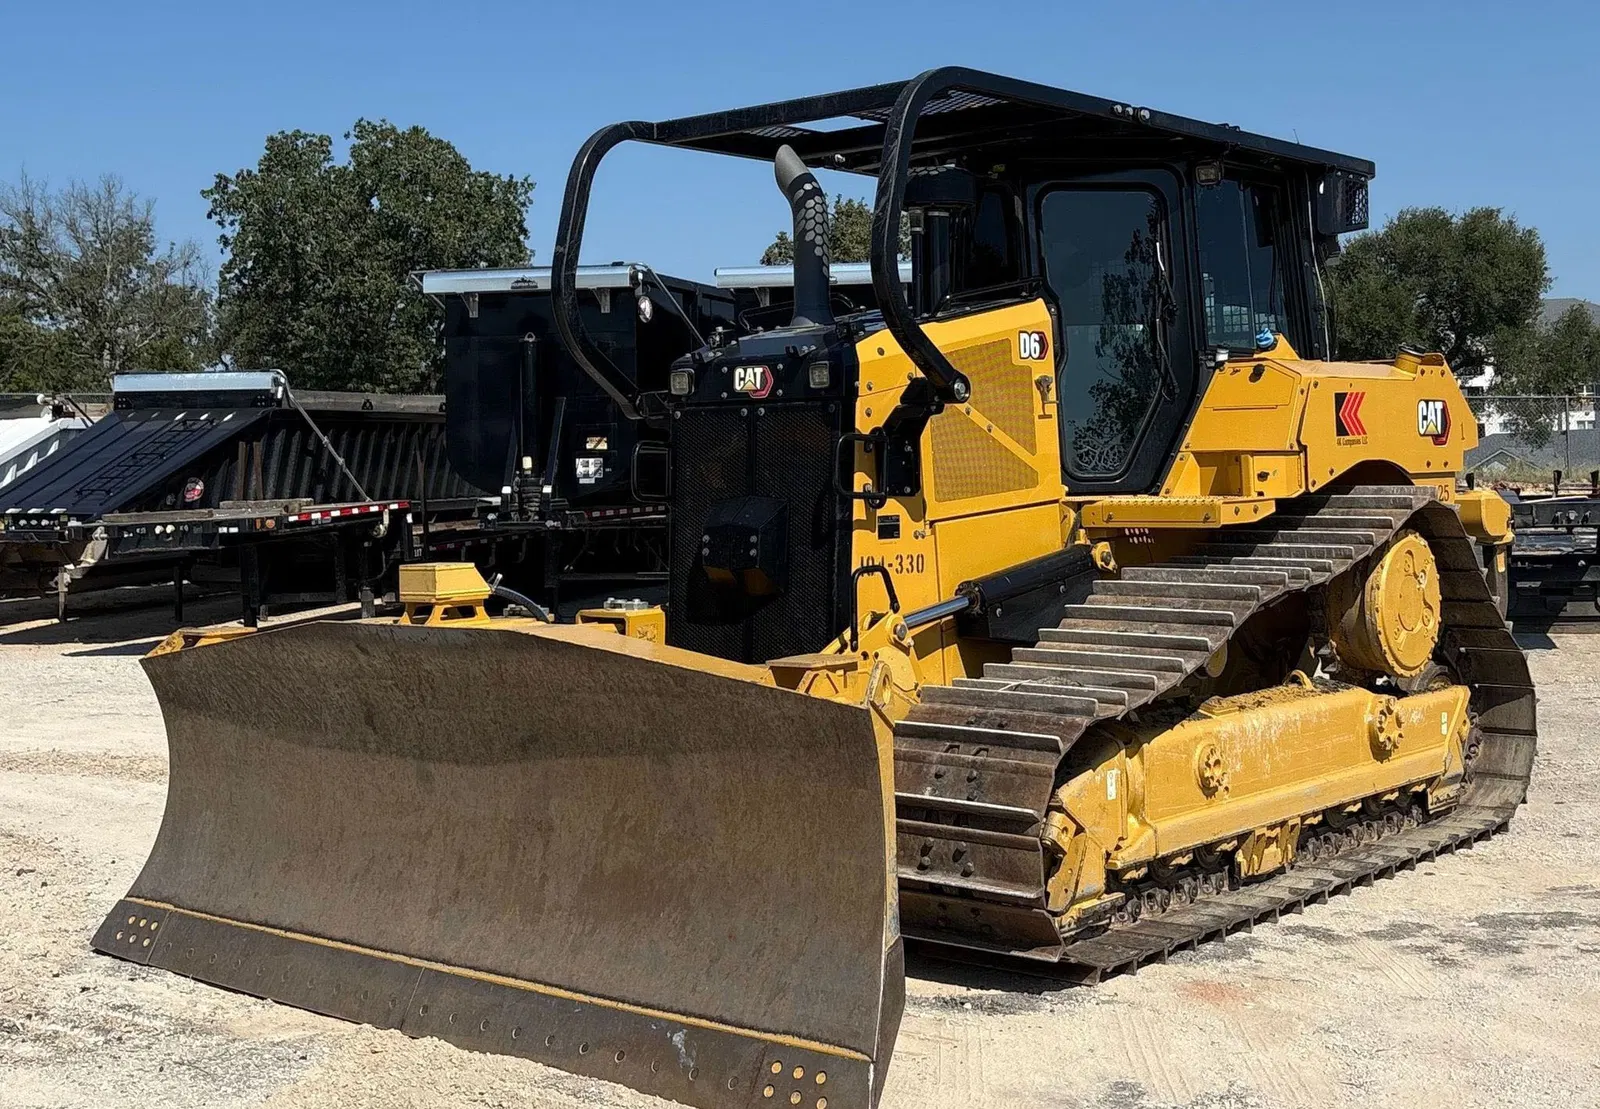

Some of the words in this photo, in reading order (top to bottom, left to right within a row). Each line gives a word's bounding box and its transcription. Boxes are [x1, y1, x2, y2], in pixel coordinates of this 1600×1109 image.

[1020, 332, 1040, 359] D6
[735, 367, 764, 391] CAT
[1418, 400, 1443, 435] CAT
[1438, 484, 1450, 502] 25
